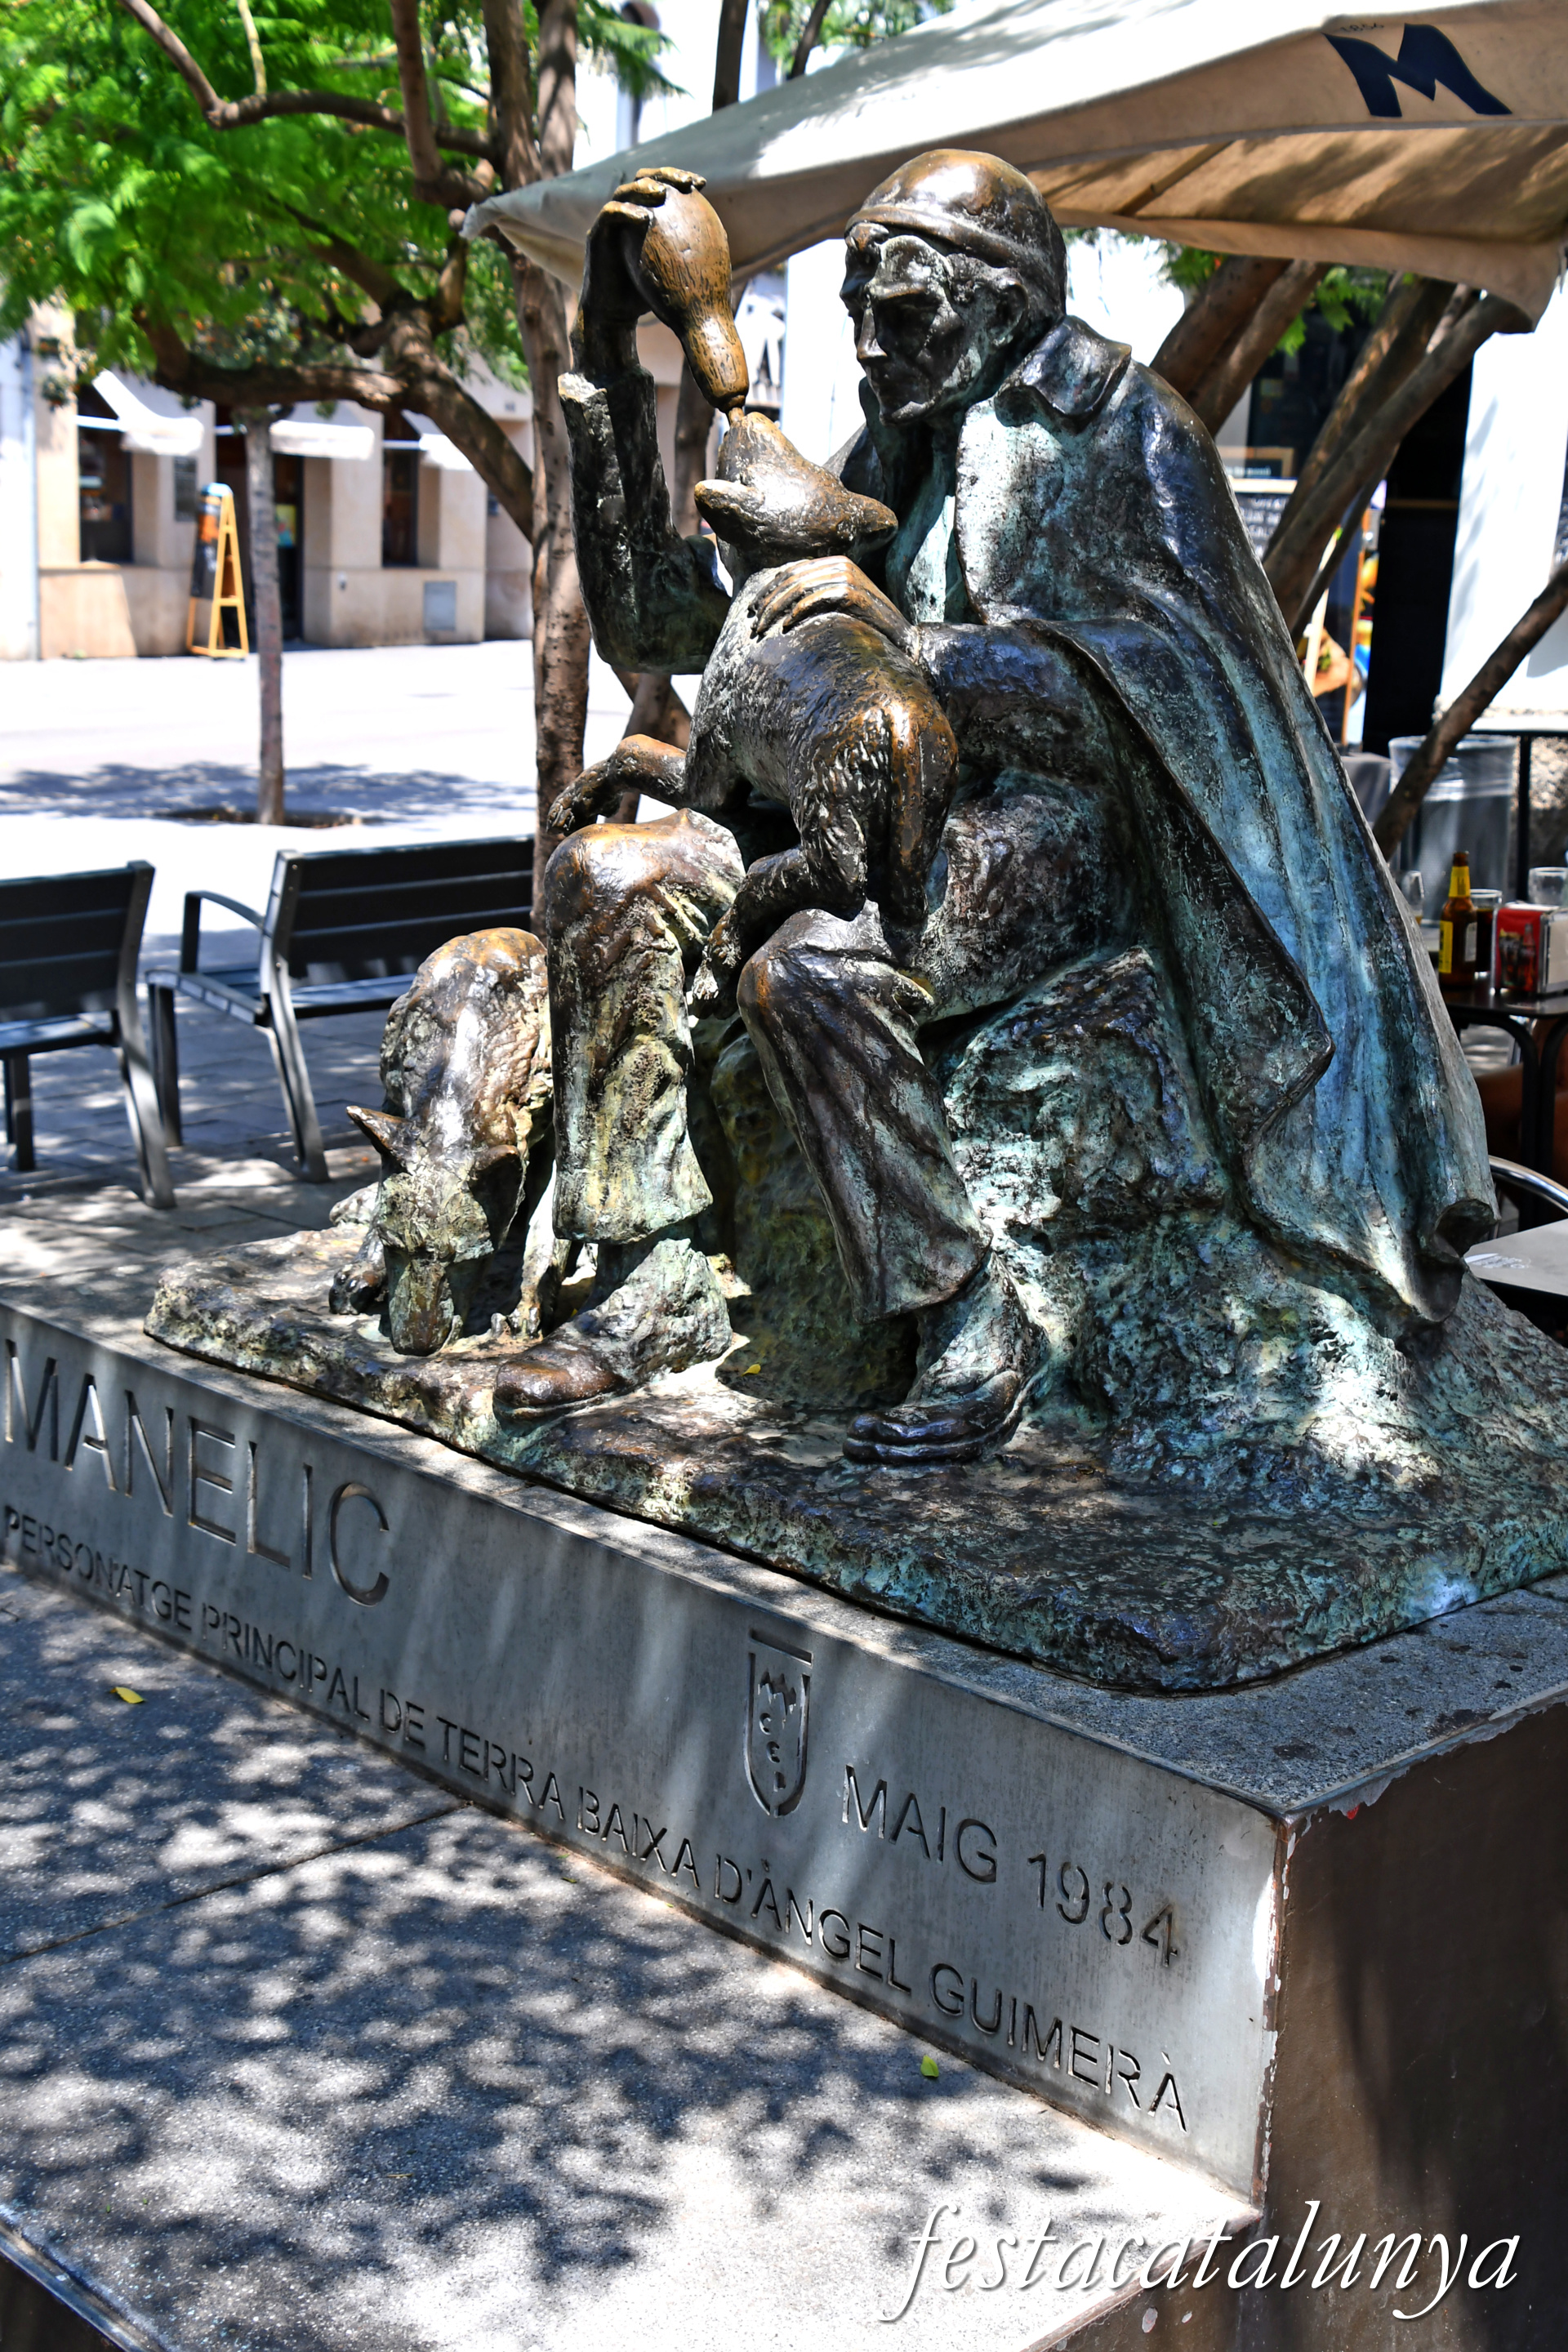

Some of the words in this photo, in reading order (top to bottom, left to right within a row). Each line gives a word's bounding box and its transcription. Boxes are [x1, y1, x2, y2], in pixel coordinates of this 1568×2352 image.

[5, 1339, 390, 1607] MANELIC
[4, 1505, 192, 1631] PERSONATGE
[201, 1602, 370, 1721] PRINCIPAL
[379, 1689, 425, 1748] DE
[437, 1716, 565, 1820] TERRA
[577, 1786, 700, 1889] BAIXA
[715, 1853, 911, 1993] D'ÀNGEL
[929, 1963, 1187, 2134] GUIMERÀ
[842, 1764, 997, 1884] MAIG
[1027, 1852, 1178, 1967] 1984
